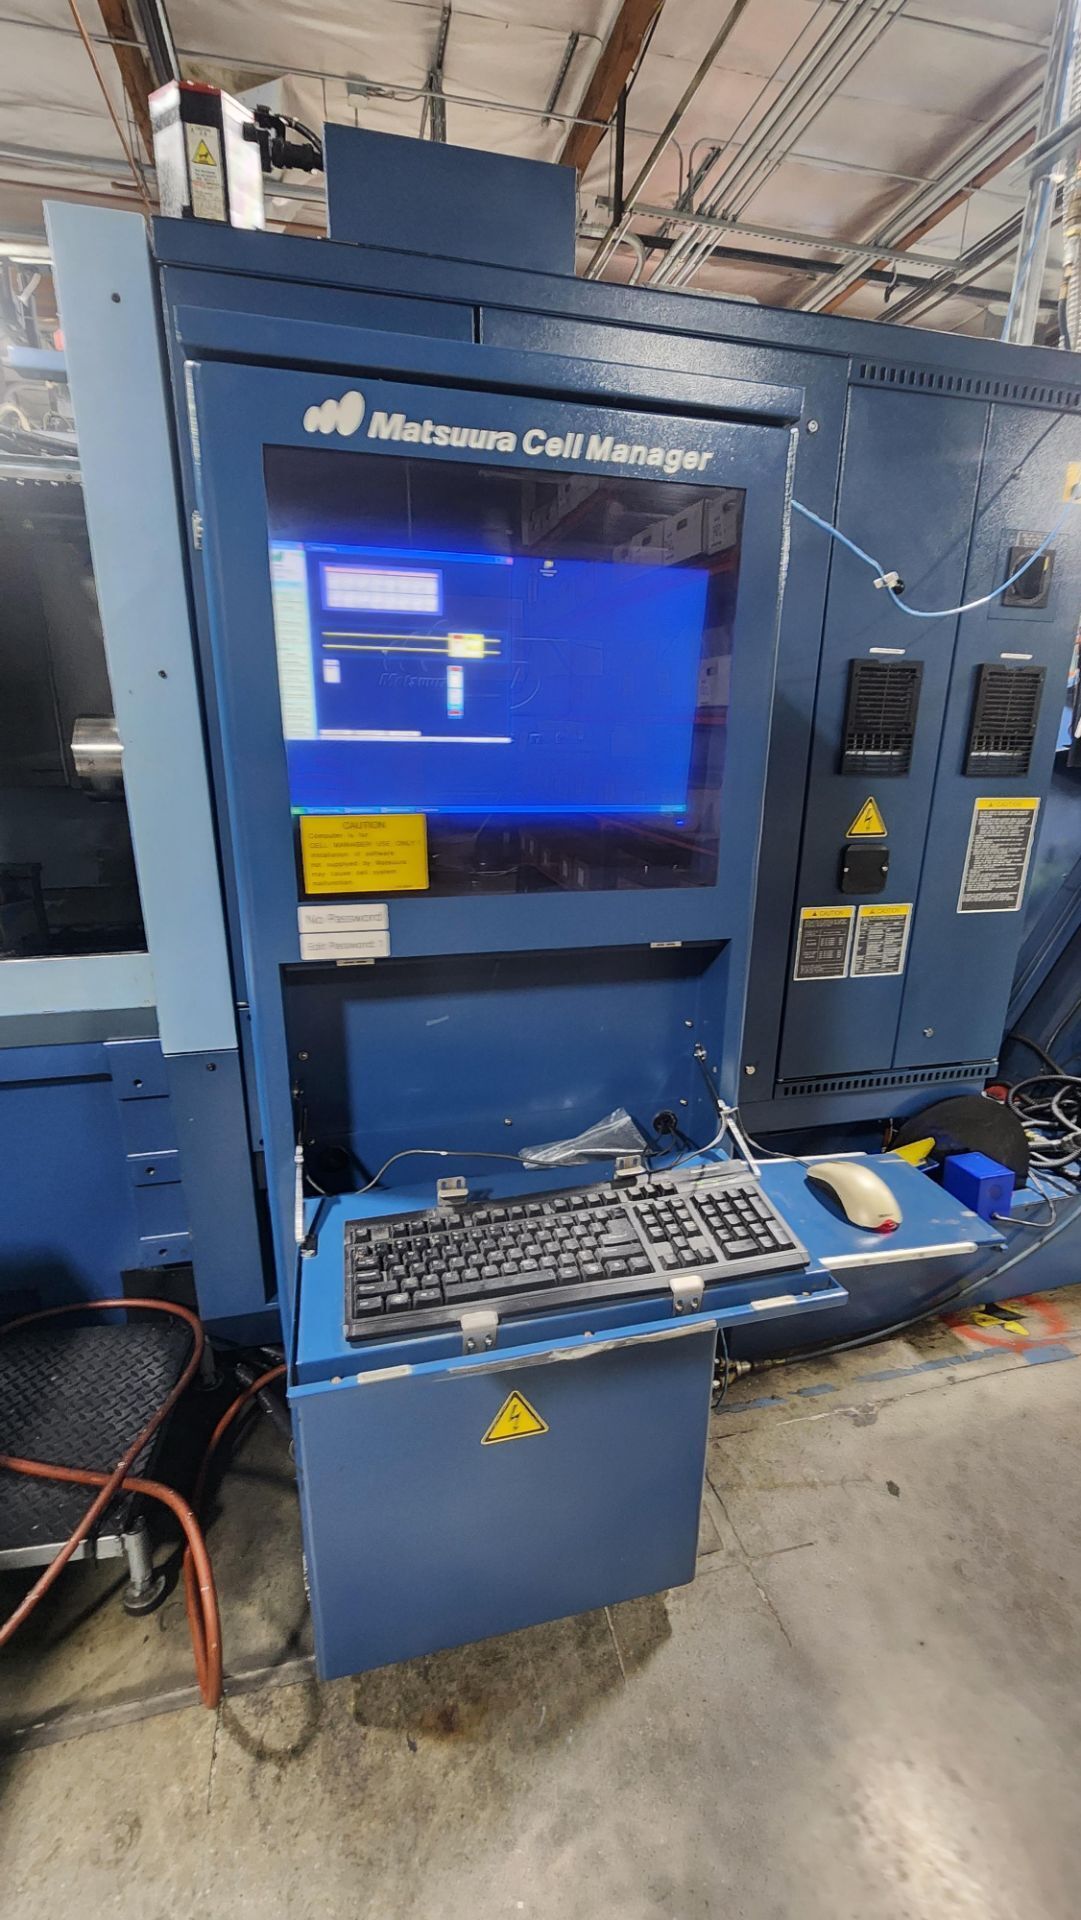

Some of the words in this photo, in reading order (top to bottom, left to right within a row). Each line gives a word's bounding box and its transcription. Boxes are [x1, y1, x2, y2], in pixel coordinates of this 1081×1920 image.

[367, 411, 516, 453] Matsuura
[522, 428, 583, 459] Cell
[585, 434, 714, 474] Manager
[342, 821, 386, 830] CAUTION
[327, 913, 383, 923] Password
